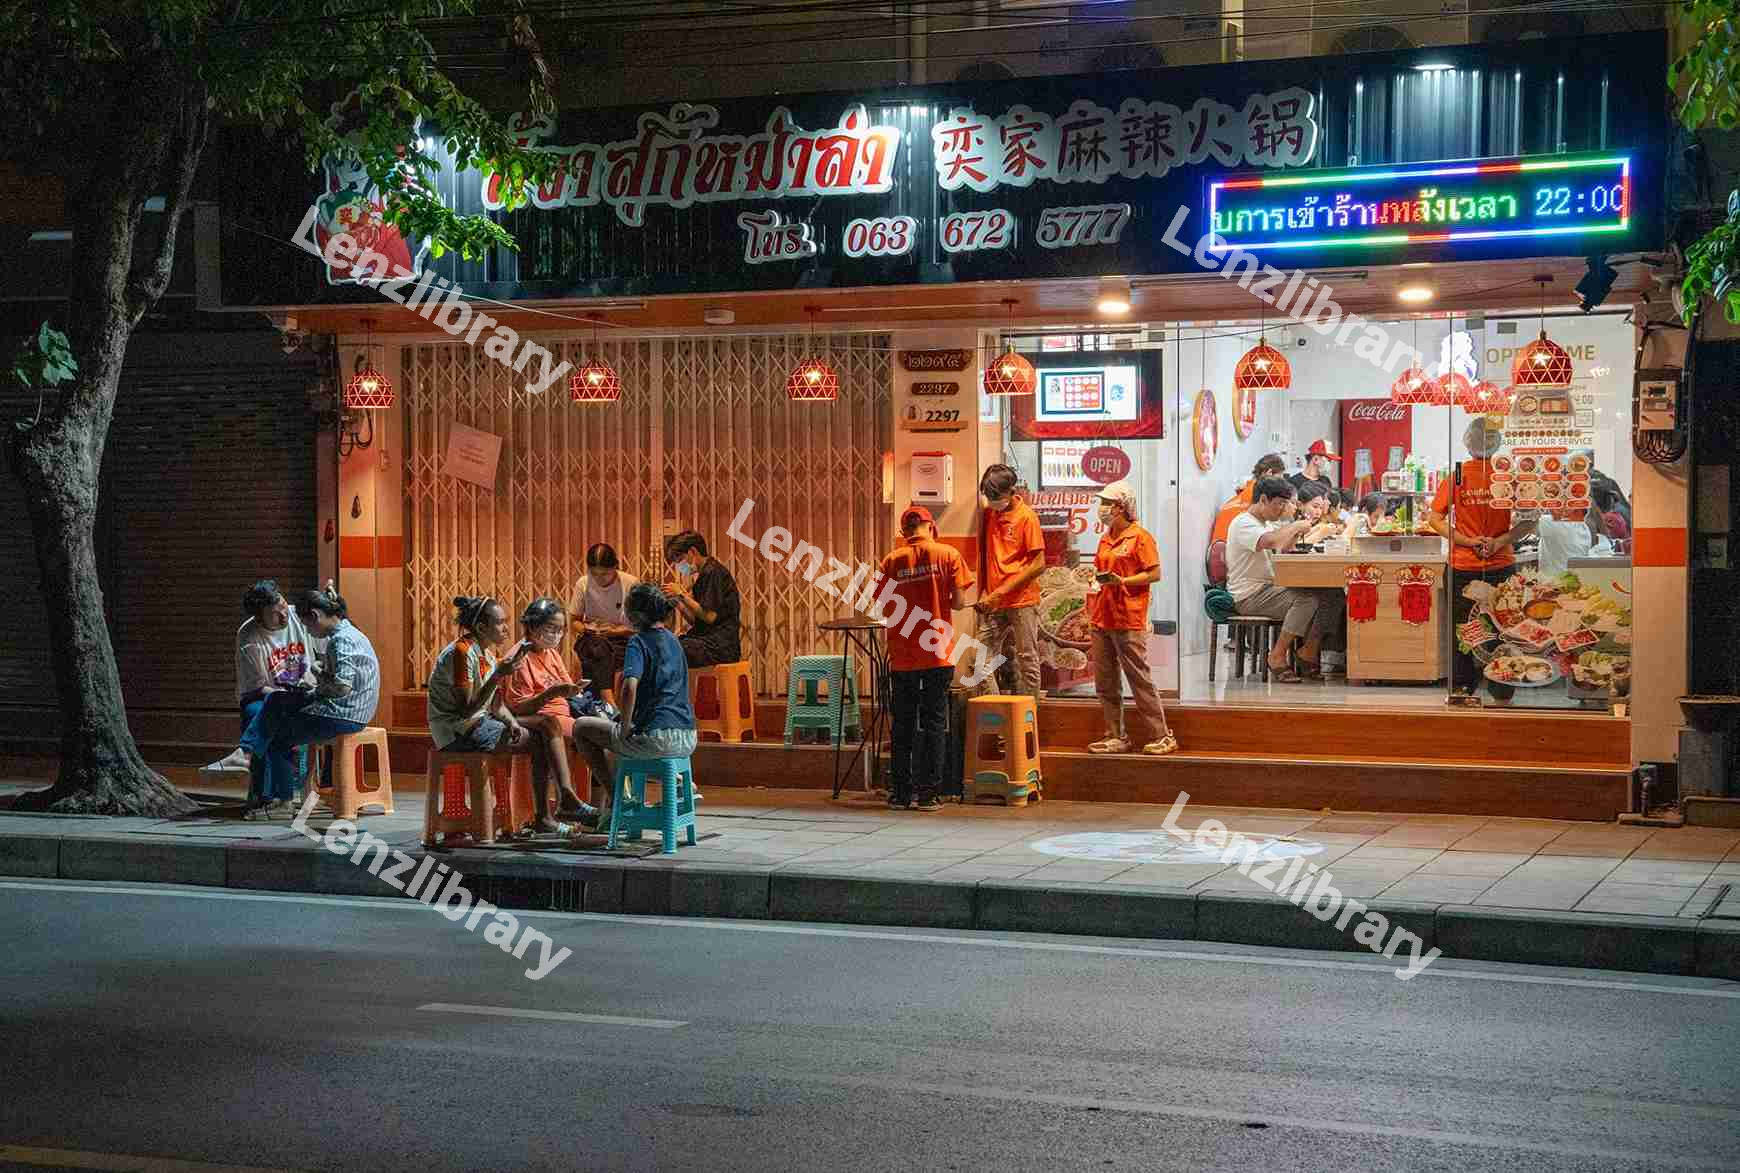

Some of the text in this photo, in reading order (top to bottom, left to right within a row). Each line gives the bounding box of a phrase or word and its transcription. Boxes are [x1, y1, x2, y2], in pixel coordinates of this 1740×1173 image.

[940, 98, 1304, 183] 奕家麻辣火锅
[847, 219, 909, 253] 063
[943, 212, 1007, 248] 672
[1040, 206, 1126, 244] 5777
[926, 409, 960, 423] 2297
[1348, 401, 1405, 420] Coca-Cola
[1090, 457, 1121, 473] OPEN
